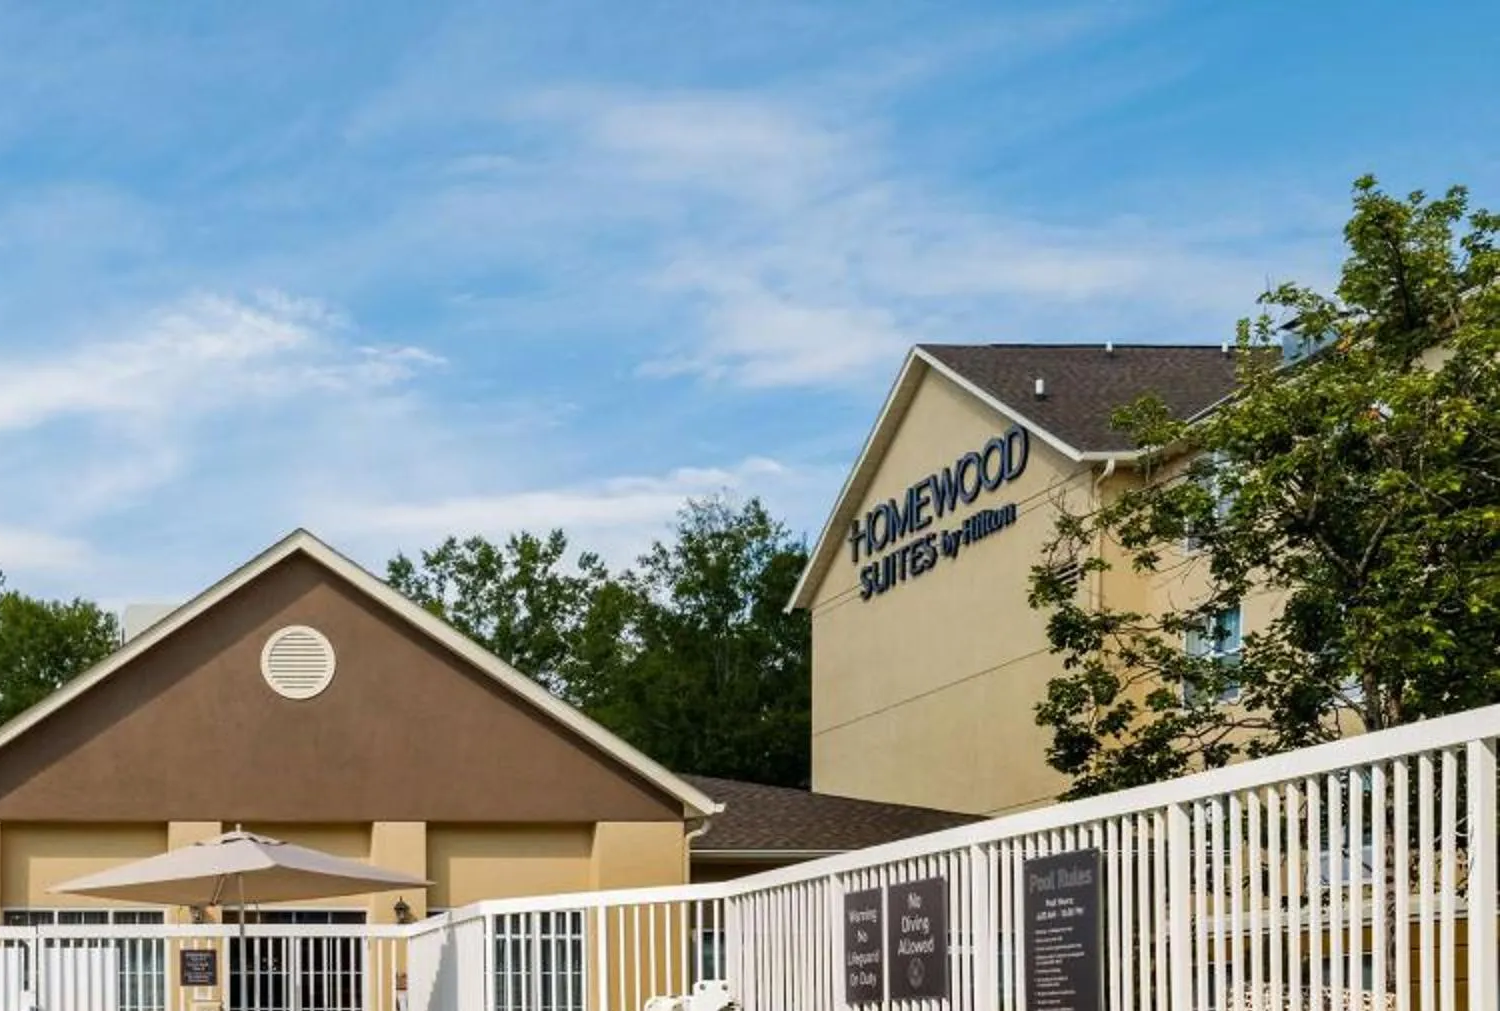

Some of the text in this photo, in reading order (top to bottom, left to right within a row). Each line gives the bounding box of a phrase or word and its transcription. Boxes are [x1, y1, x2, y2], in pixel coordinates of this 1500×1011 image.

[848, 424, 1029, 562] HOMEWOOD
[860, 503, 1017, 601] SUITES by Hilton
[1029, 866, 1092, 894] Pool Rules
[908, 892, 921, 909] No
[901, 914, 930, 934] Diving
[857, 929, 868, 943] No
[898, 935, 935, 956] Allowed
[860, 971, 877, 988] Duty
